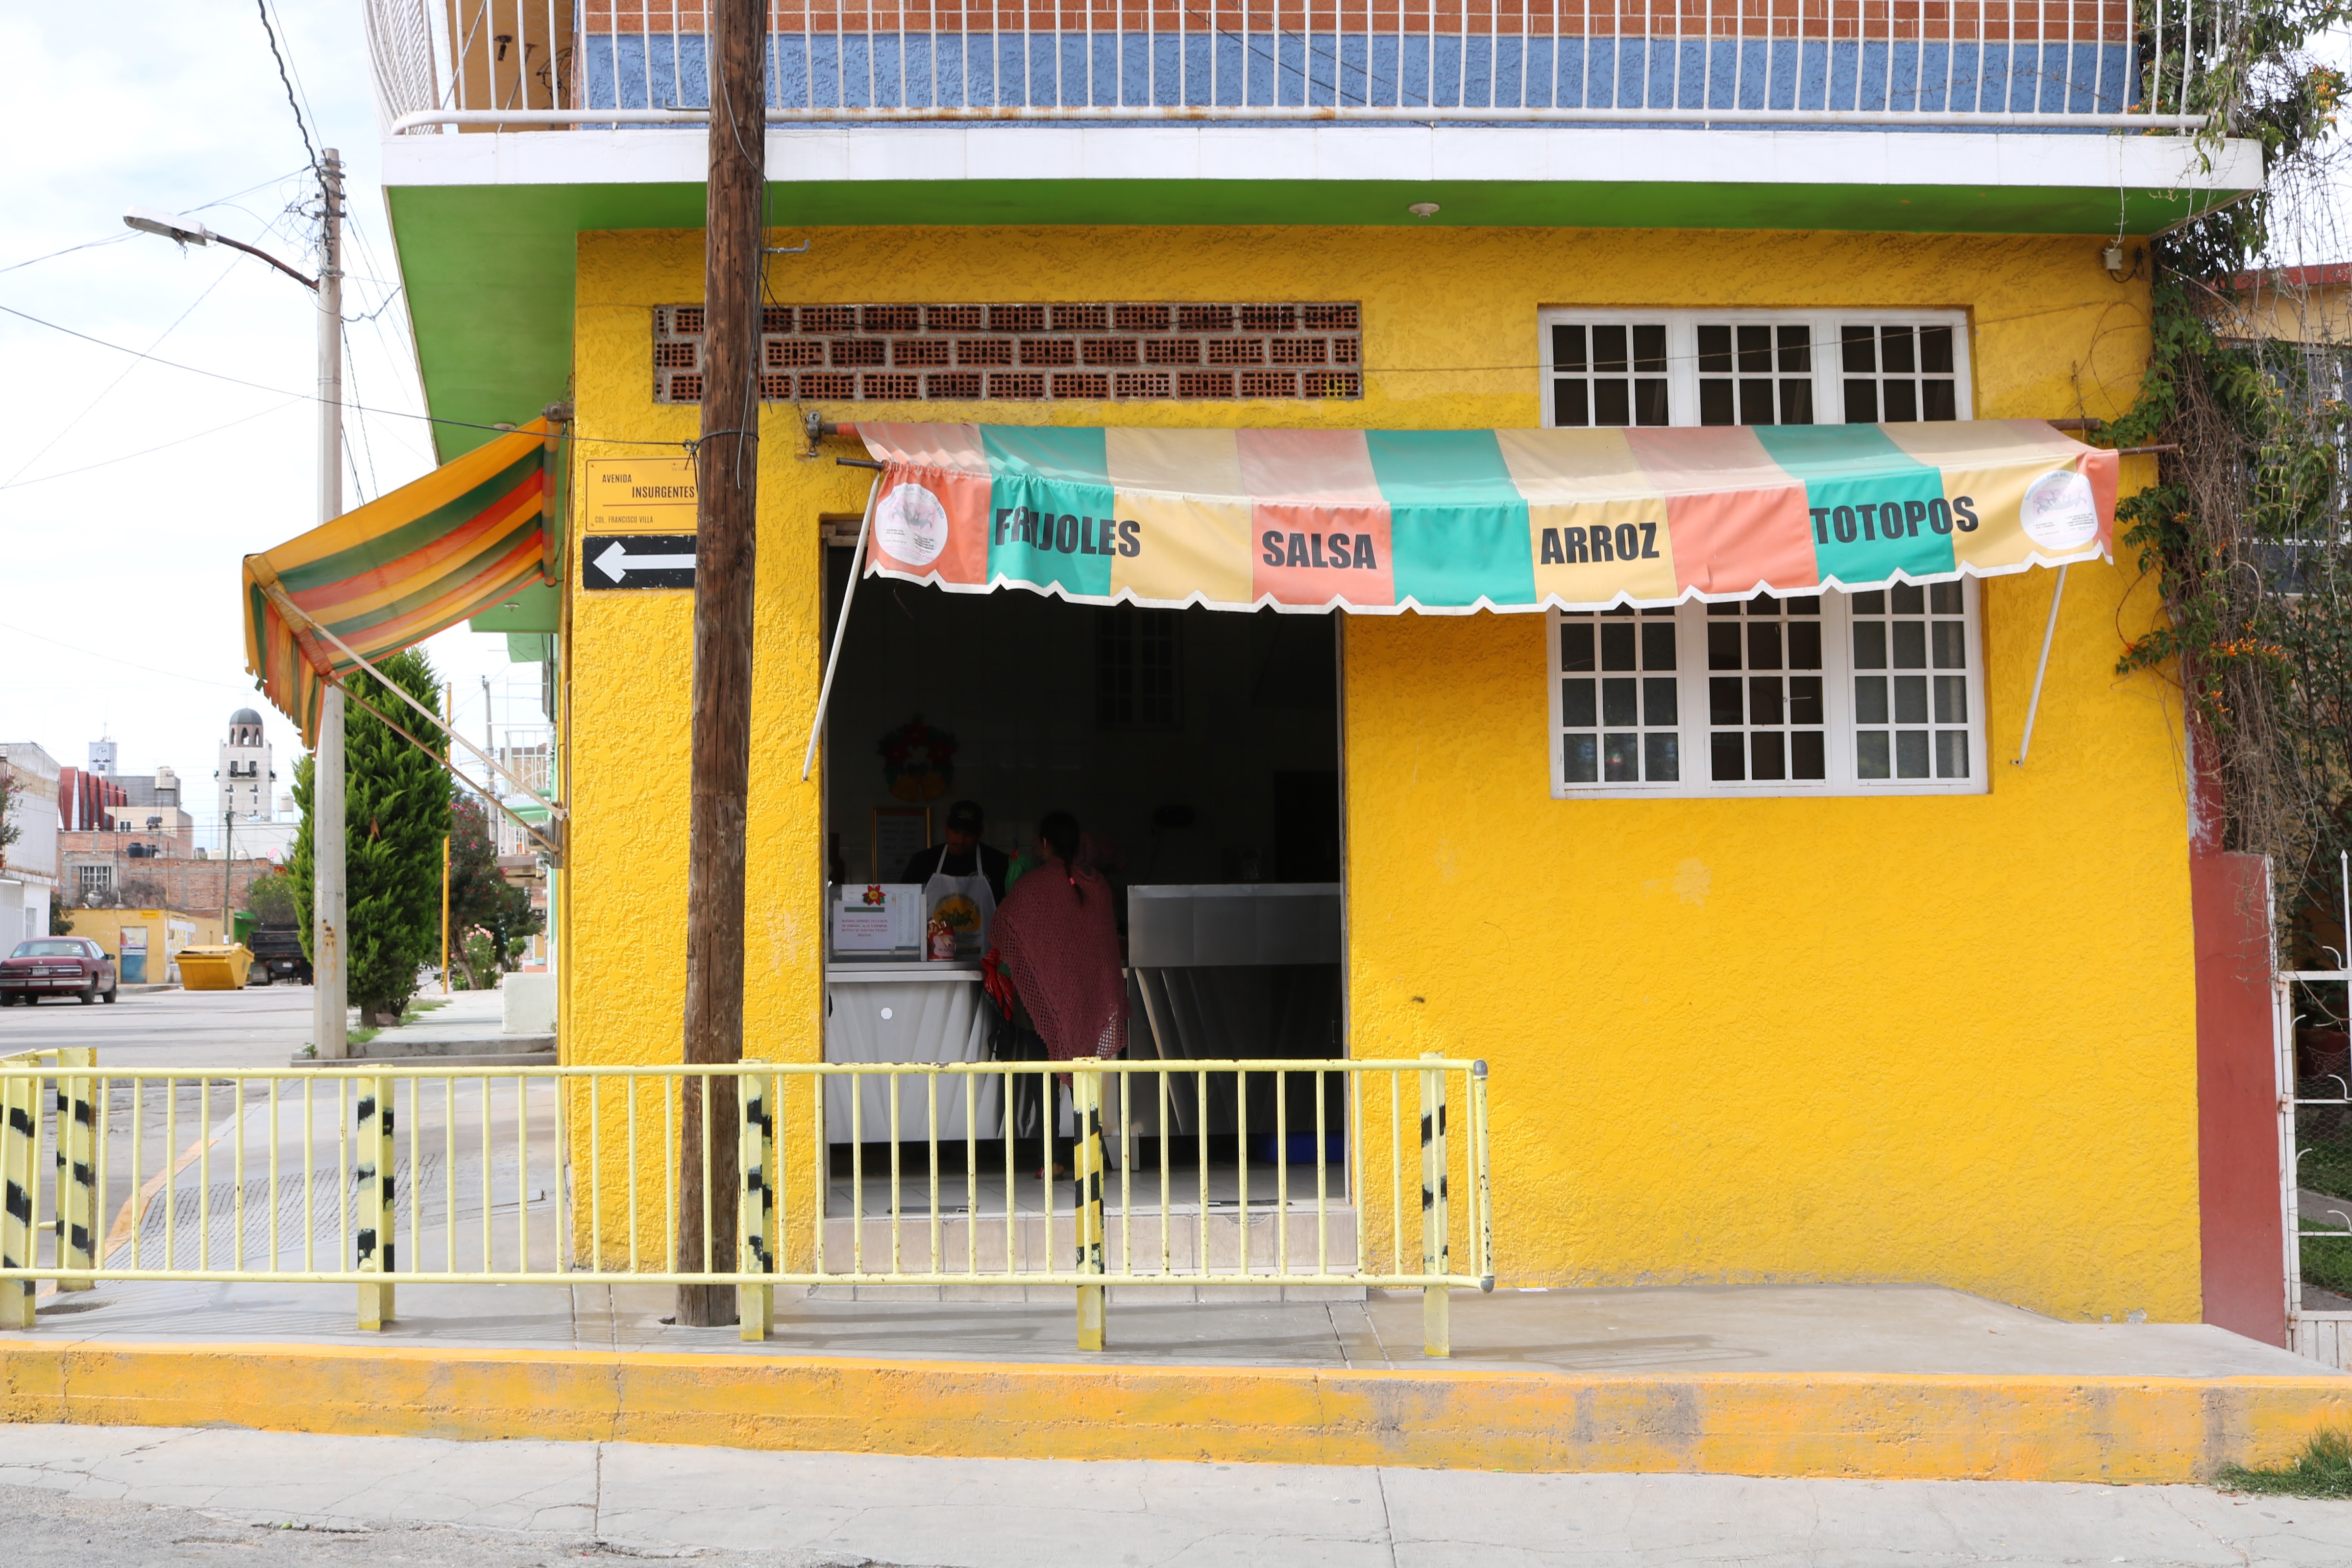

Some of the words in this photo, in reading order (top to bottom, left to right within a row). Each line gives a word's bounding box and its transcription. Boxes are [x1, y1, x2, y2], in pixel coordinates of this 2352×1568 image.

[602, 474, 632, 483] AVENIDA
[632, 486, 694, 498] INSURGENTES
[995, 505, 1141, 557] FRIJOLES
[1809, 496, 1979, 544] TOTOPOS
[1262, 531, 1376, 568] SALSA
[1541, 522, 1660, 564] ARROZ
